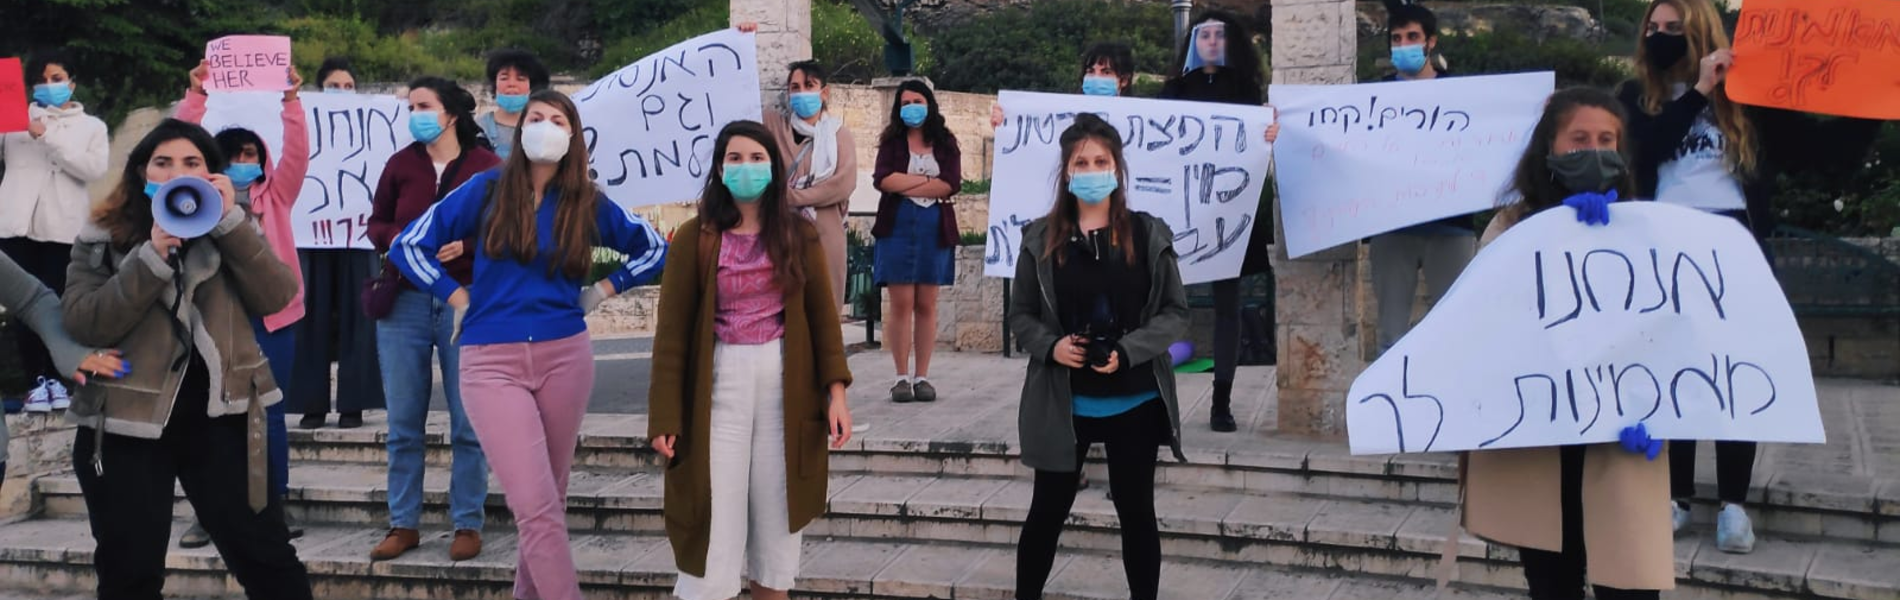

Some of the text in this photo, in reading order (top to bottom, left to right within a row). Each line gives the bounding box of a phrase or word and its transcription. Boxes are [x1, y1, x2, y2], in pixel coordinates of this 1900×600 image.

[209, 52, 287, 69] BELIEVE
[210, 39, 231, 51] WE
[213, 69, 254, 88] HER
[641, 92, 714, 132] וגם
[309, 103, 400, 162] אנחנ
[1122, 114, 1247, 155] הפצת
[1535, 249, 1726, 329] אנחנו
[1360, 354, 1776, 453] מאמינות לך
